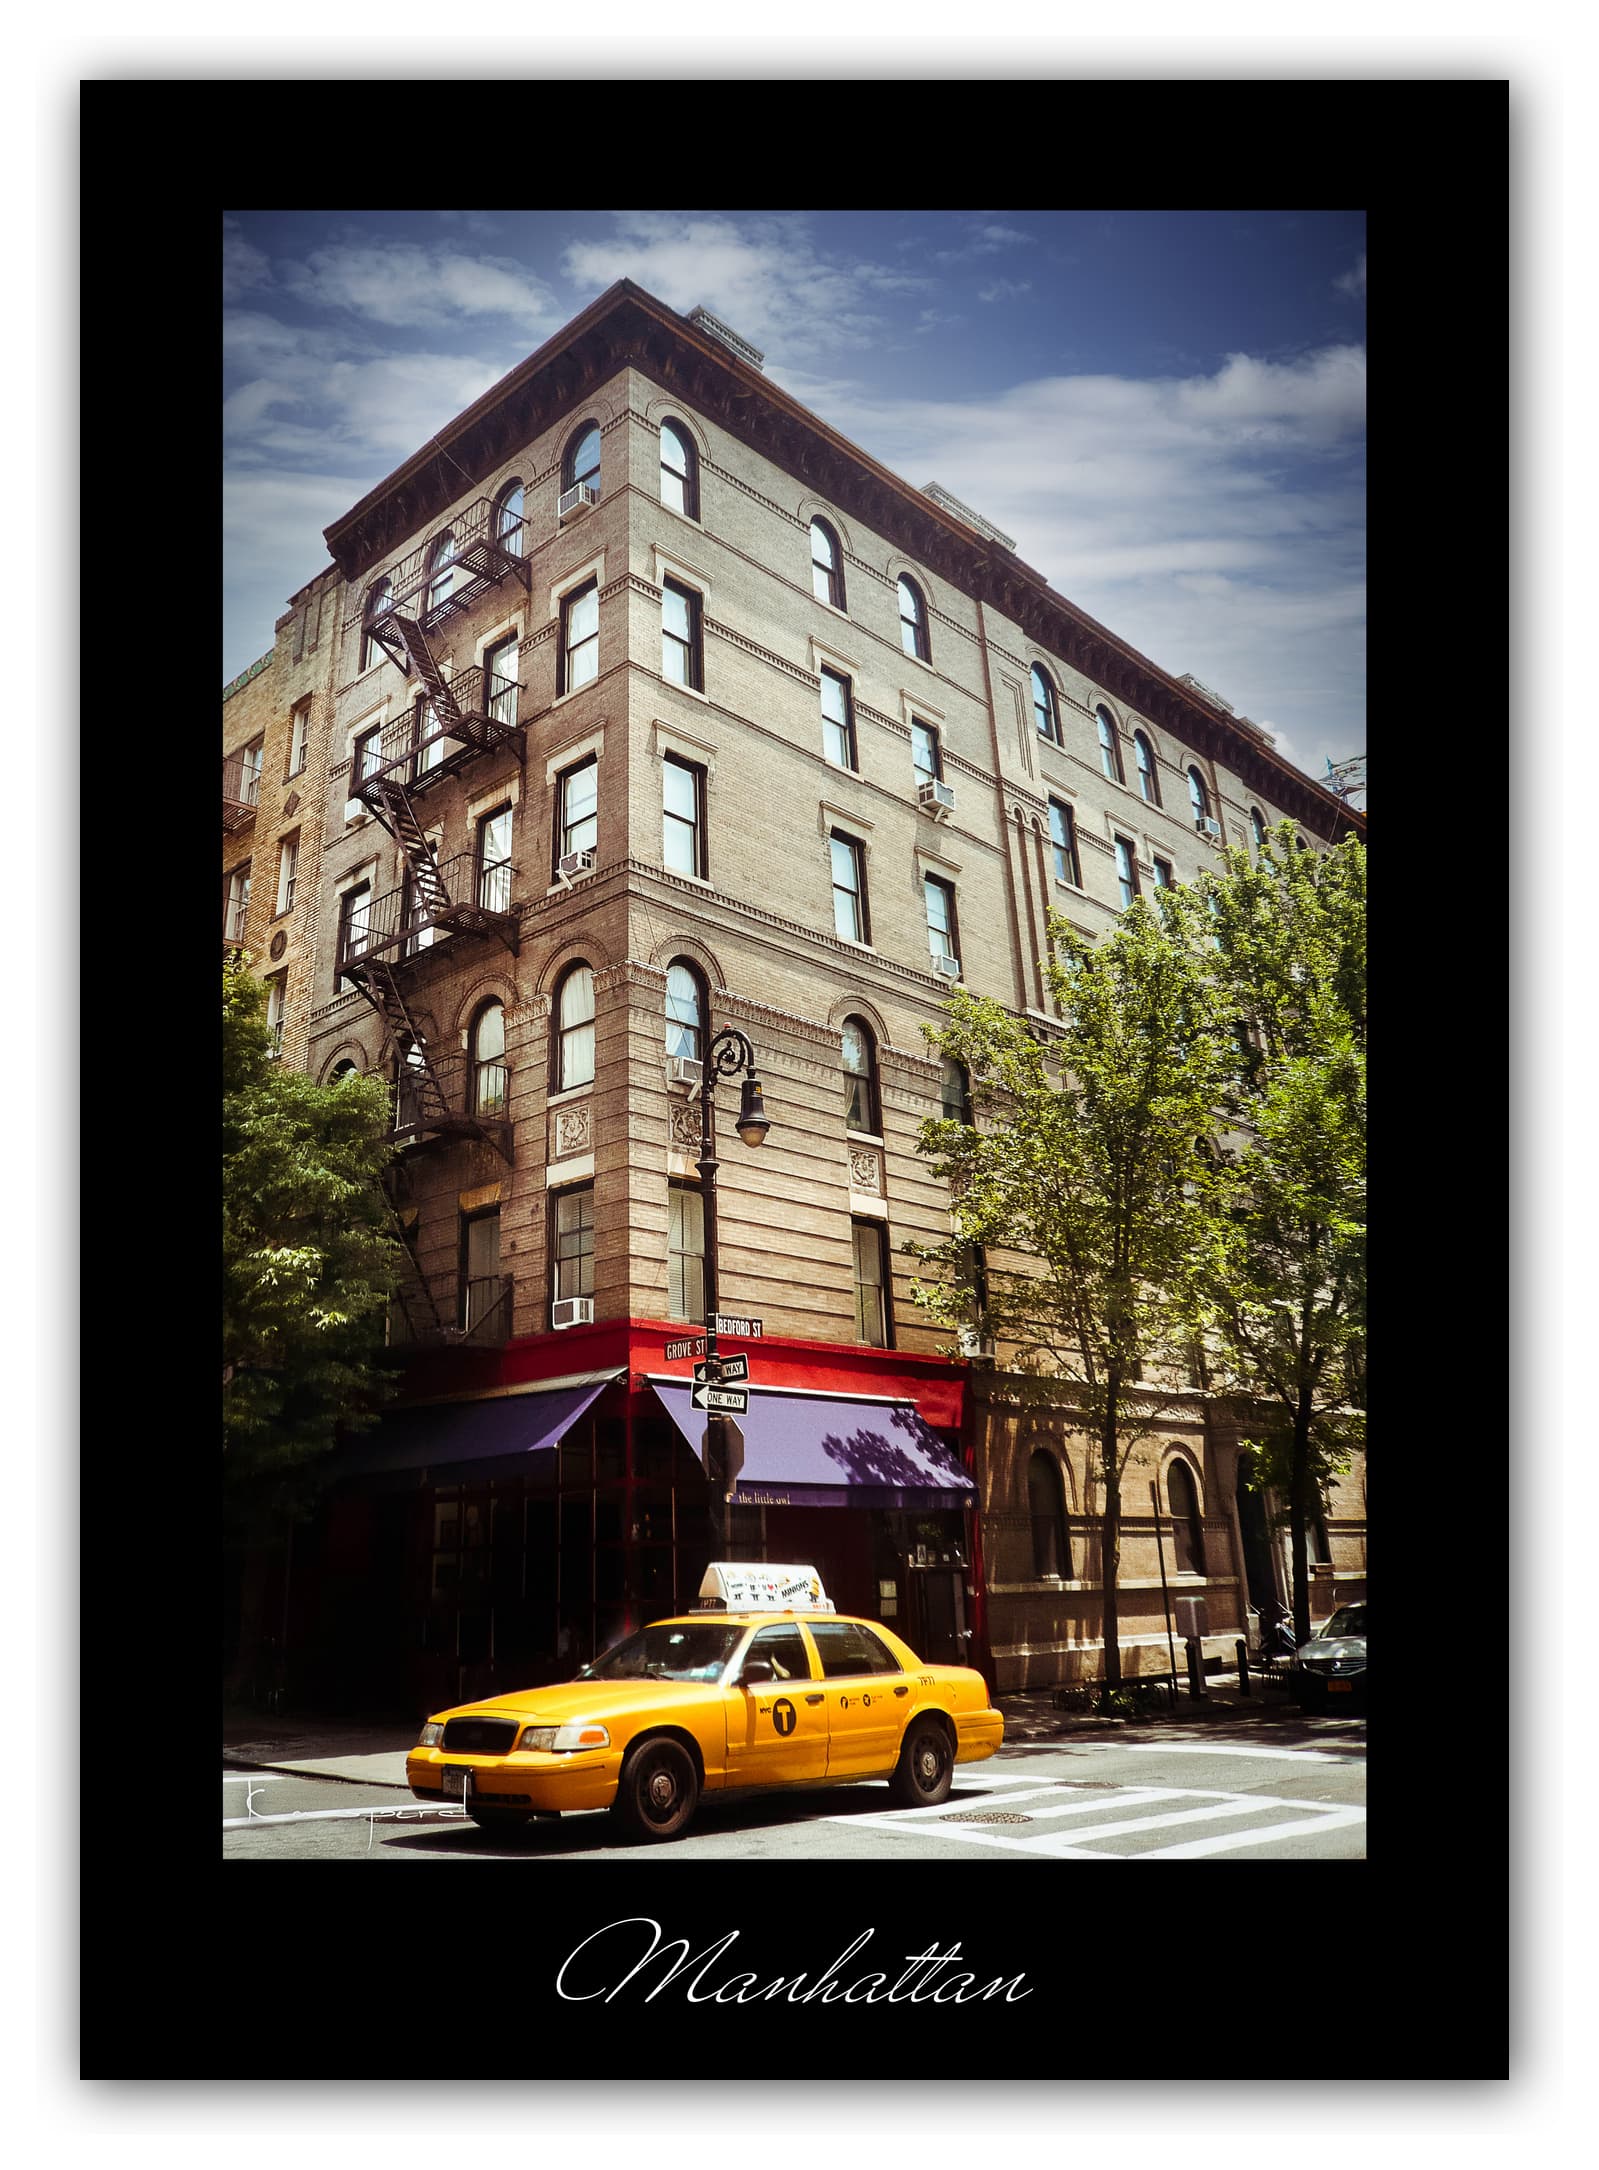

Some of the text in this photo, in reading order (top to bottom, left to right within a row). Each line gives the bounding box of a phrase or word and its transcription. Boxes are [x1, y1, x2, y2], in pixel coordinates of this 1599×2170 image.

[718, 1318, 761, 1338] BEDFORD ST
[667, 1339, 705, 1360] GROVE ST
[725, 1362, 742, 1377] WAY
[707, 1392, 743, 1406] ONE WAY
[739, 1491, 790, 1504] the little owl
[781, 1580, 809, 1598] MINIONS
